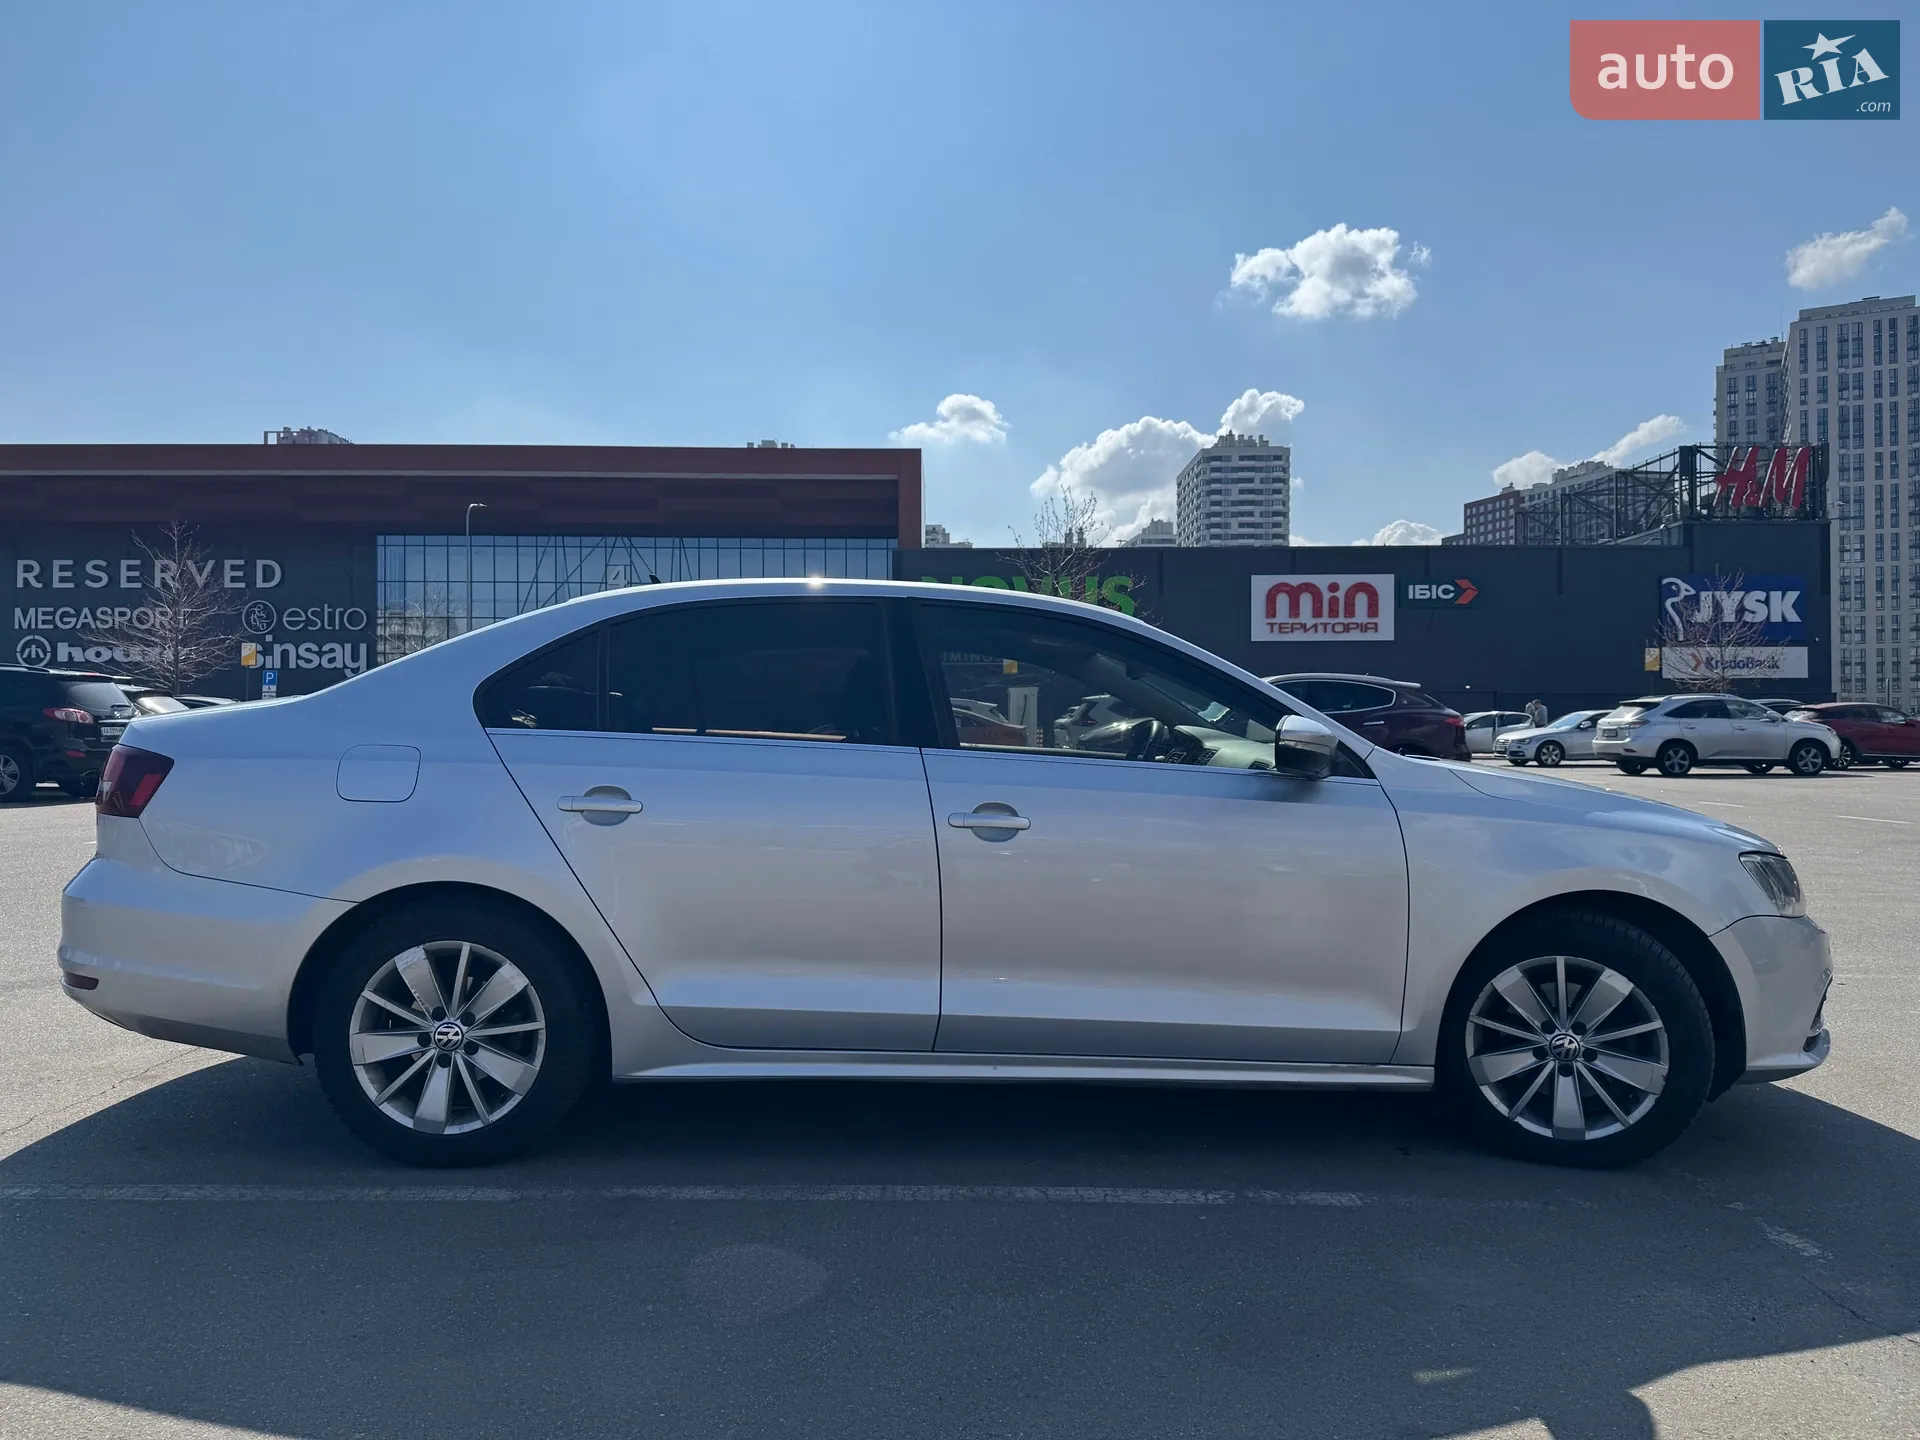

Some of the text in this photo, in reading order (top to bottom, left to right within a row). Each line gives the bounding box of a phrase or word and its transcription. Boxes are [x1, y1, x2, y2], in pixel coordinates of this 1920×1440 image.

[1713, 446, 1812, 510] H&M
[16, 559, 282, 588] RESERVED
[1408, 584, 1455, 600] ІБІС
[14, 607, 191, 630] MEGASPORT
[282, 603, 367, 631] estro
[1695, 590, 1802, 623] JYSK
[1266, 622, 1379, 634] ТЕРИТОРІЯ
